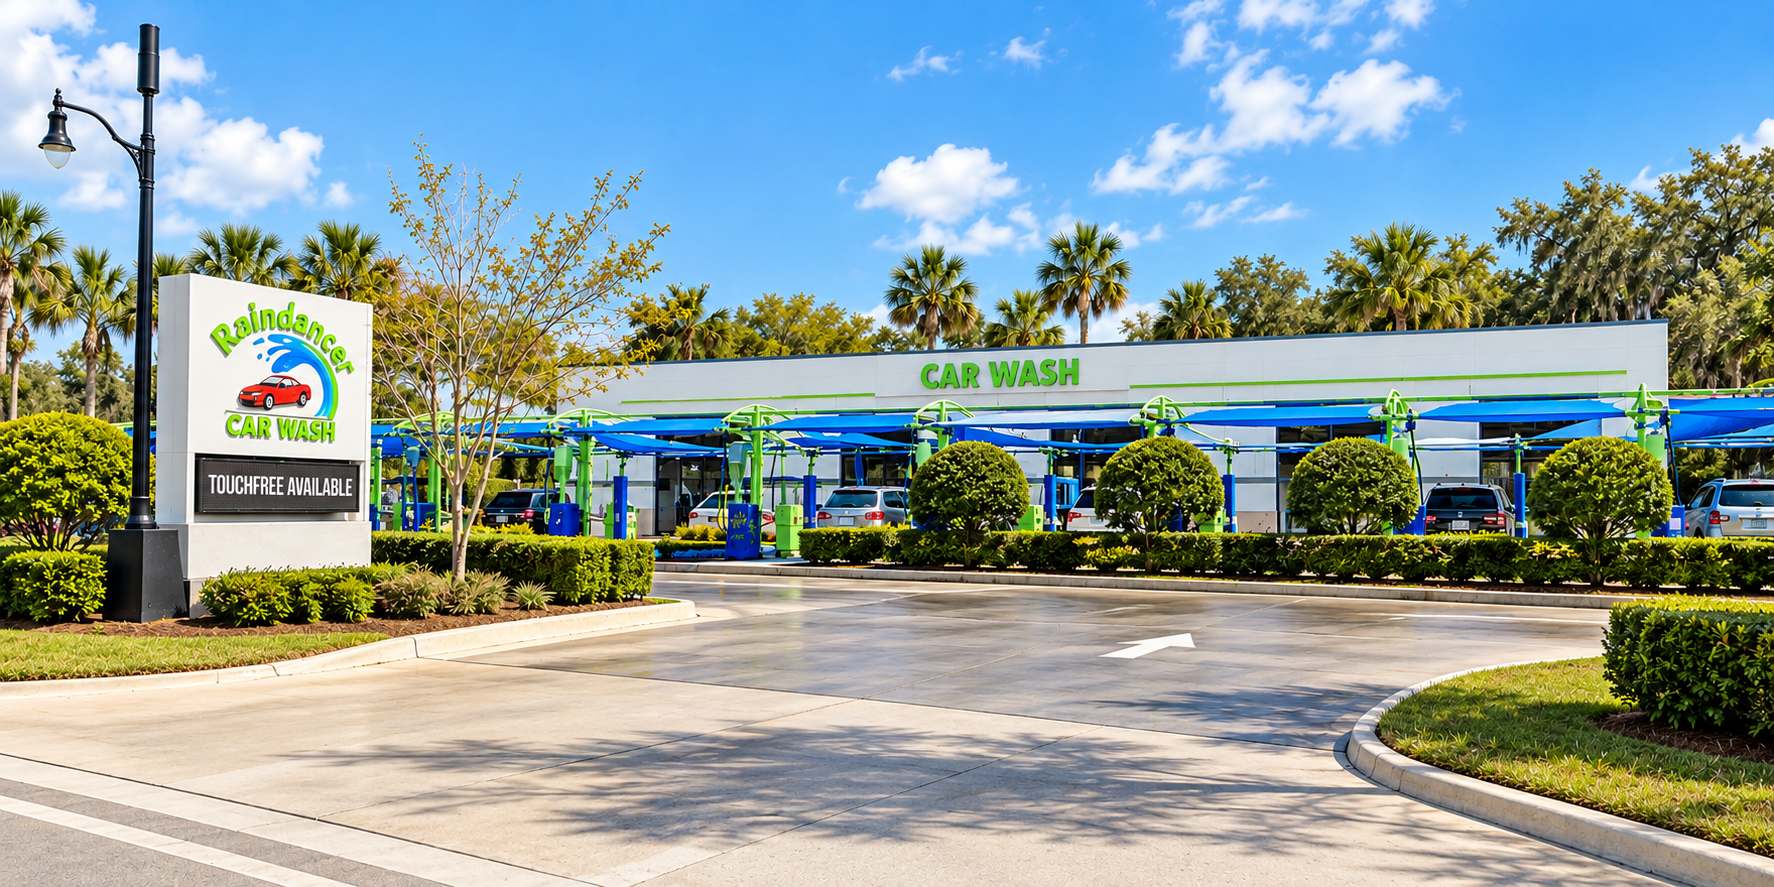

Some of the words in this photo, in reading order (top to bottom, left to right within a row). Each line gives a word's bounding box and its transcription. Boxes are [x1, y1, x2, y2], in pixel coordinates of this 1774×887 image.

[209, 302, 354, 374] Raindancer
[920, 362, 980, 389] CAR
[989, 358, 1080, 387] WASH
[225, 414, 272, 439] CAR
[277, 417, 336, 443] WASH
[208, 474, 284, 496] TOUCHFREE
[287, 476, 353, 497] AVAILABLE
